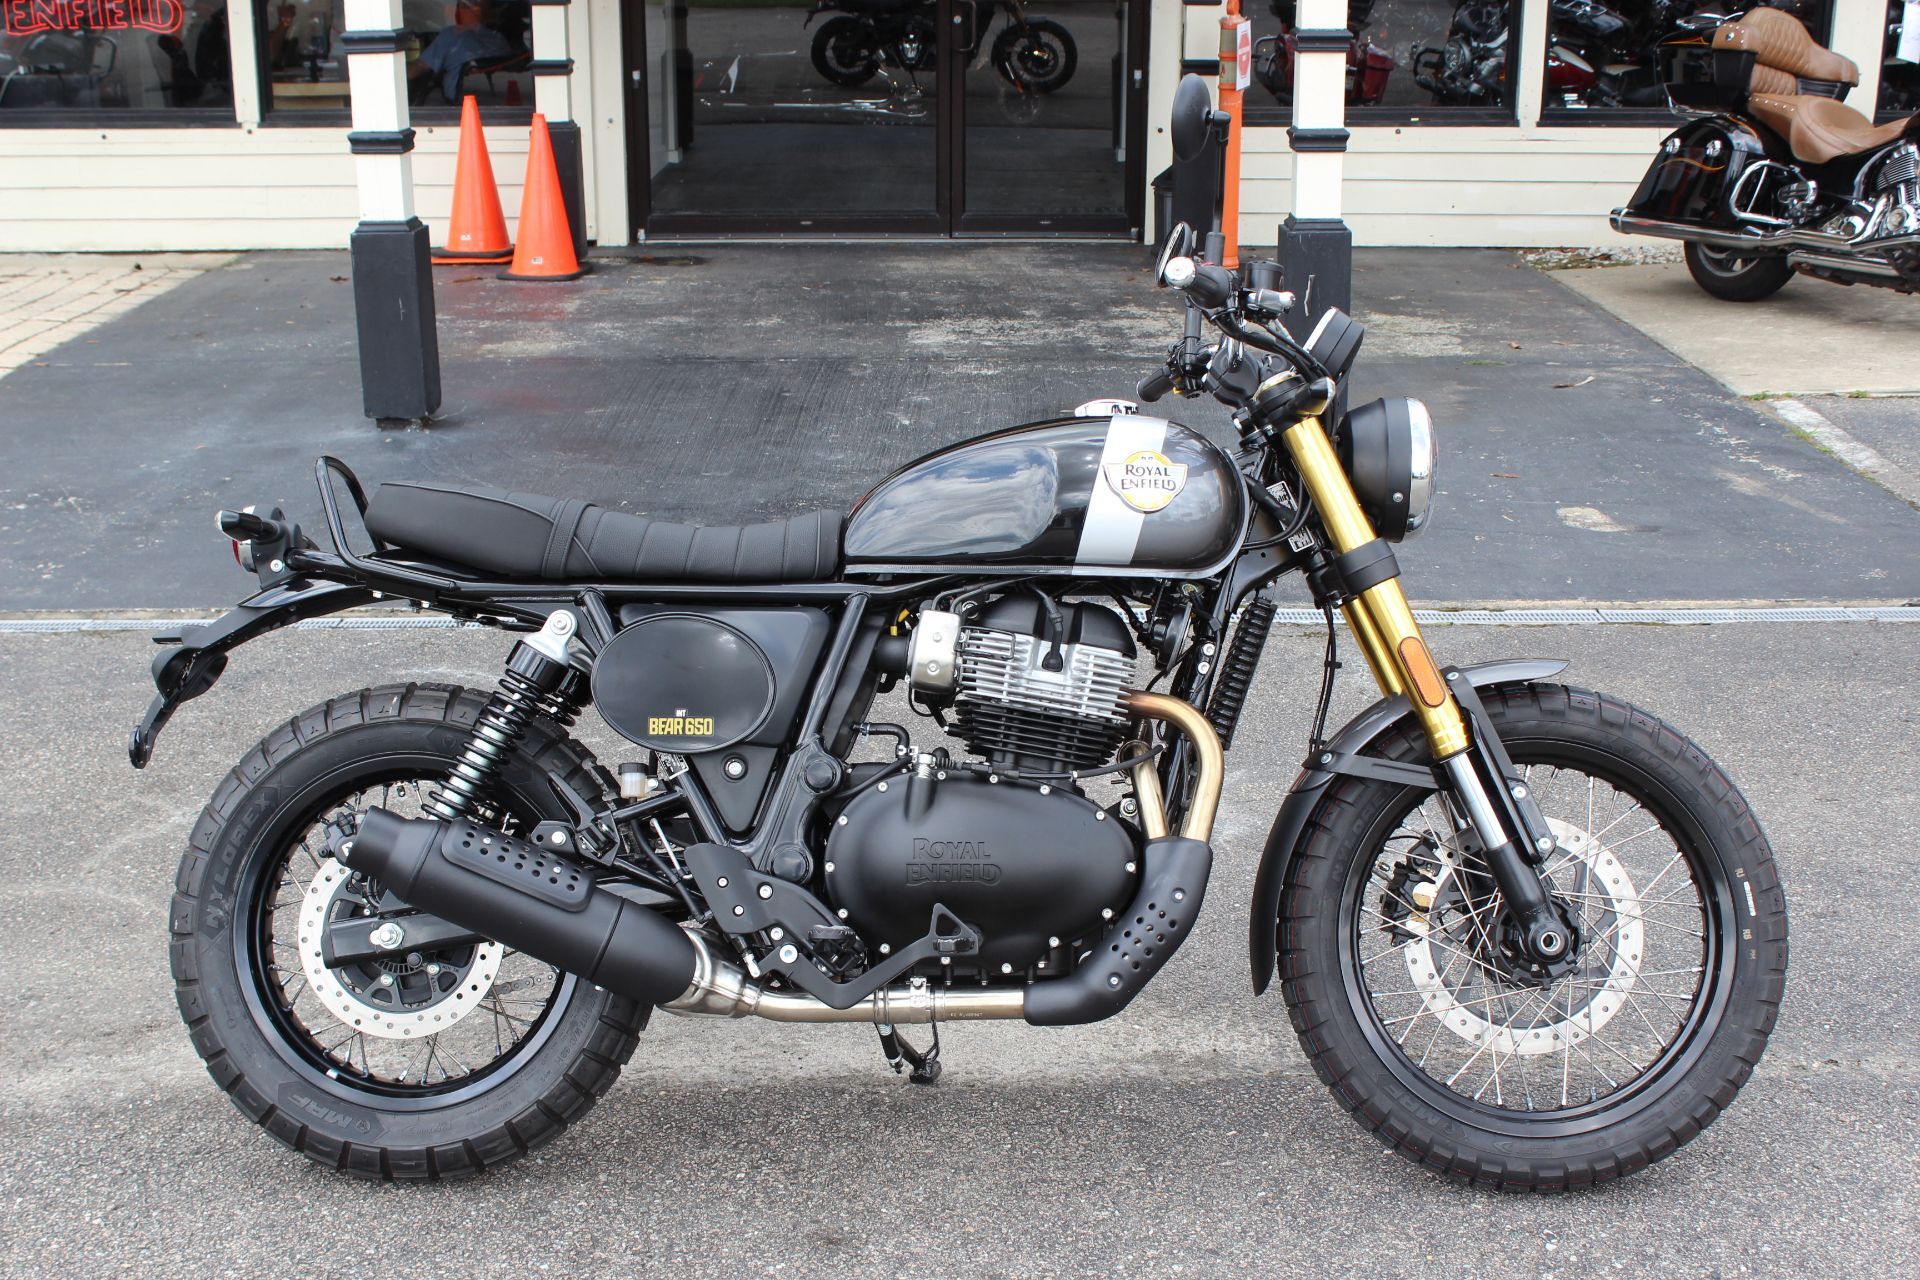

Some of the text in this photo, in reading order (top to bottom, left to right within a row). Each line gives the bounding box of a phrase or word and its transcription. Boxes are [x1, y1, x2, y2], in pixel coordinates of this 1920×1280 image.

[3, 0, 184, 36] ENFIELD
[1125, 463, 1172, 477] ROYAL
[1120, 478, 1177, 492] ENFIELD
[675, 709, 687, 717] INT
[648, 718, 713, 735] BEAR 650
[912, 837, 991, 860] ROYAL
[205, 792, 272, 929] NYLOREX
[905, 863, 1003, 886] ENFIELD
[287, 1093, 353, 1129] MRF
